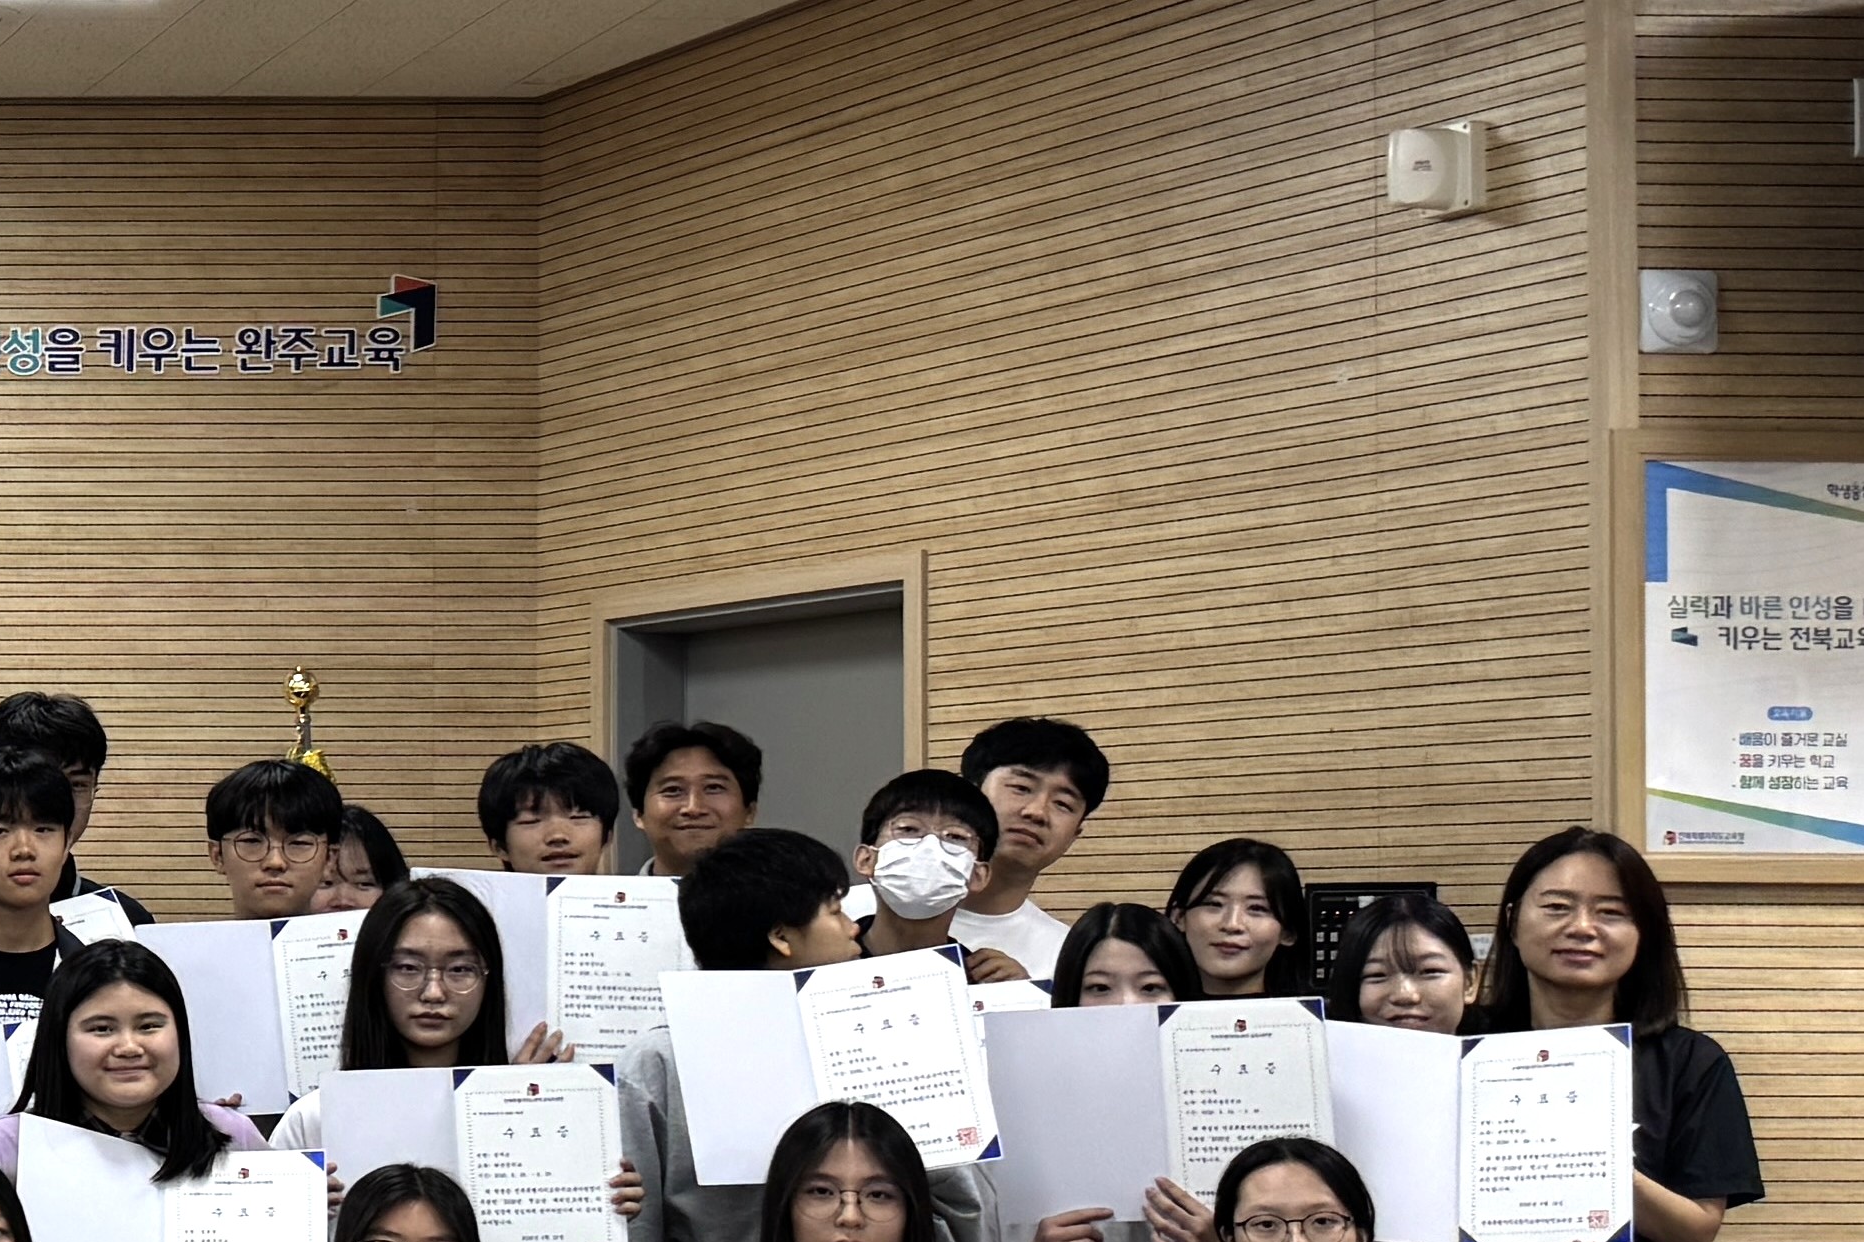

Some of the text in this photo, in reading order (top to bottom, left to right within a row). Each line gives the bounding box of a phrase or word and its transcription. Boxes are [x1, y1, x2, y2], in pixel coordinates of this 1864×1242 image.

[97, 327, 223, 374] 키우는
[234, 326, 405, 373] 완주교육
[1827, 482, 1864, 500] 학생중
[1668, 596, 1854, 620] 실력과 바른 인성을
[1718, 627, 1782, 650] 키우는
[1768, 754, 1805, 768] 키우는
[1810, 754, 1835, 768] 학교
